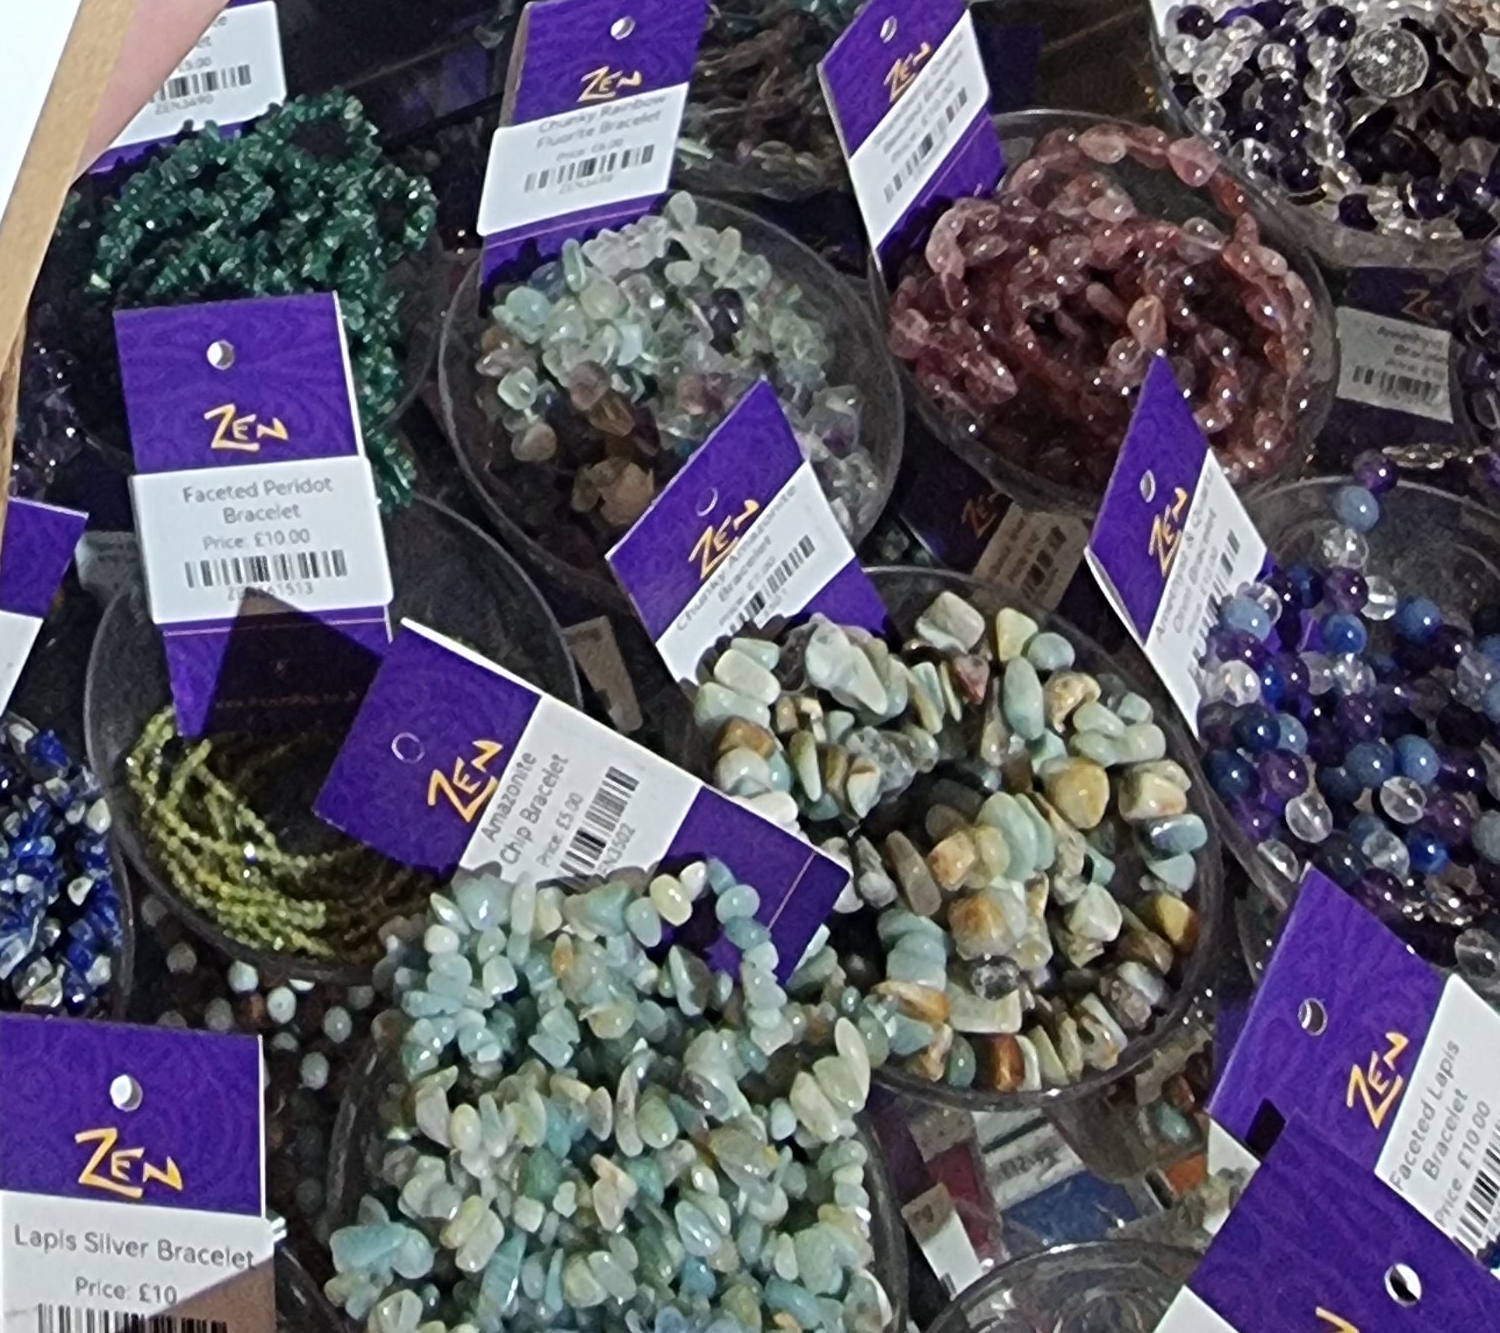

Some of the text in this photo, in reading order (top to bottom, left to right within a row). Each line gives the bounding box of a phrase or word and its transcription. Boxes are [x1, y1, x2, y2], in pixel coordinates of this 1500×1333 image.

[576, 66, 642, 102] ZEN
[883, 41, 931, 102] ZEN
[536, 109, 662, 149] Fluorite Bracelet
[539, 95, 668, 134] Chunky Rainbow
[204, 403, 289, 452] ZEN
[183, 477, 333, 503] Faceted Peridot
[222, 504, 302, 525] Bracelet
[688, 499, 759, 579] ZEN
[1148, 487, 1188, 577] ZEN
[719, 535, 772, 602] Bracelet
[676, 571, 726, 631] Chunky
[427, 740, 503, 823] ZEN
[480, 751, 538, 843] Amazonite
[500, 753, 569, 865] Chip Bracelet
[1347, 1033, 1409, 1129] ZEN
[1389, 1039, 1460, 1192] Faceted Lapis
[1422, 1088, 1469, 1181] Bracelet
[75, 1127, 183, 1199] ZEN
[14, 1223, 257, 1271] Lapis Silver Bracelet
[139, 1284, 178, 1306] £10
